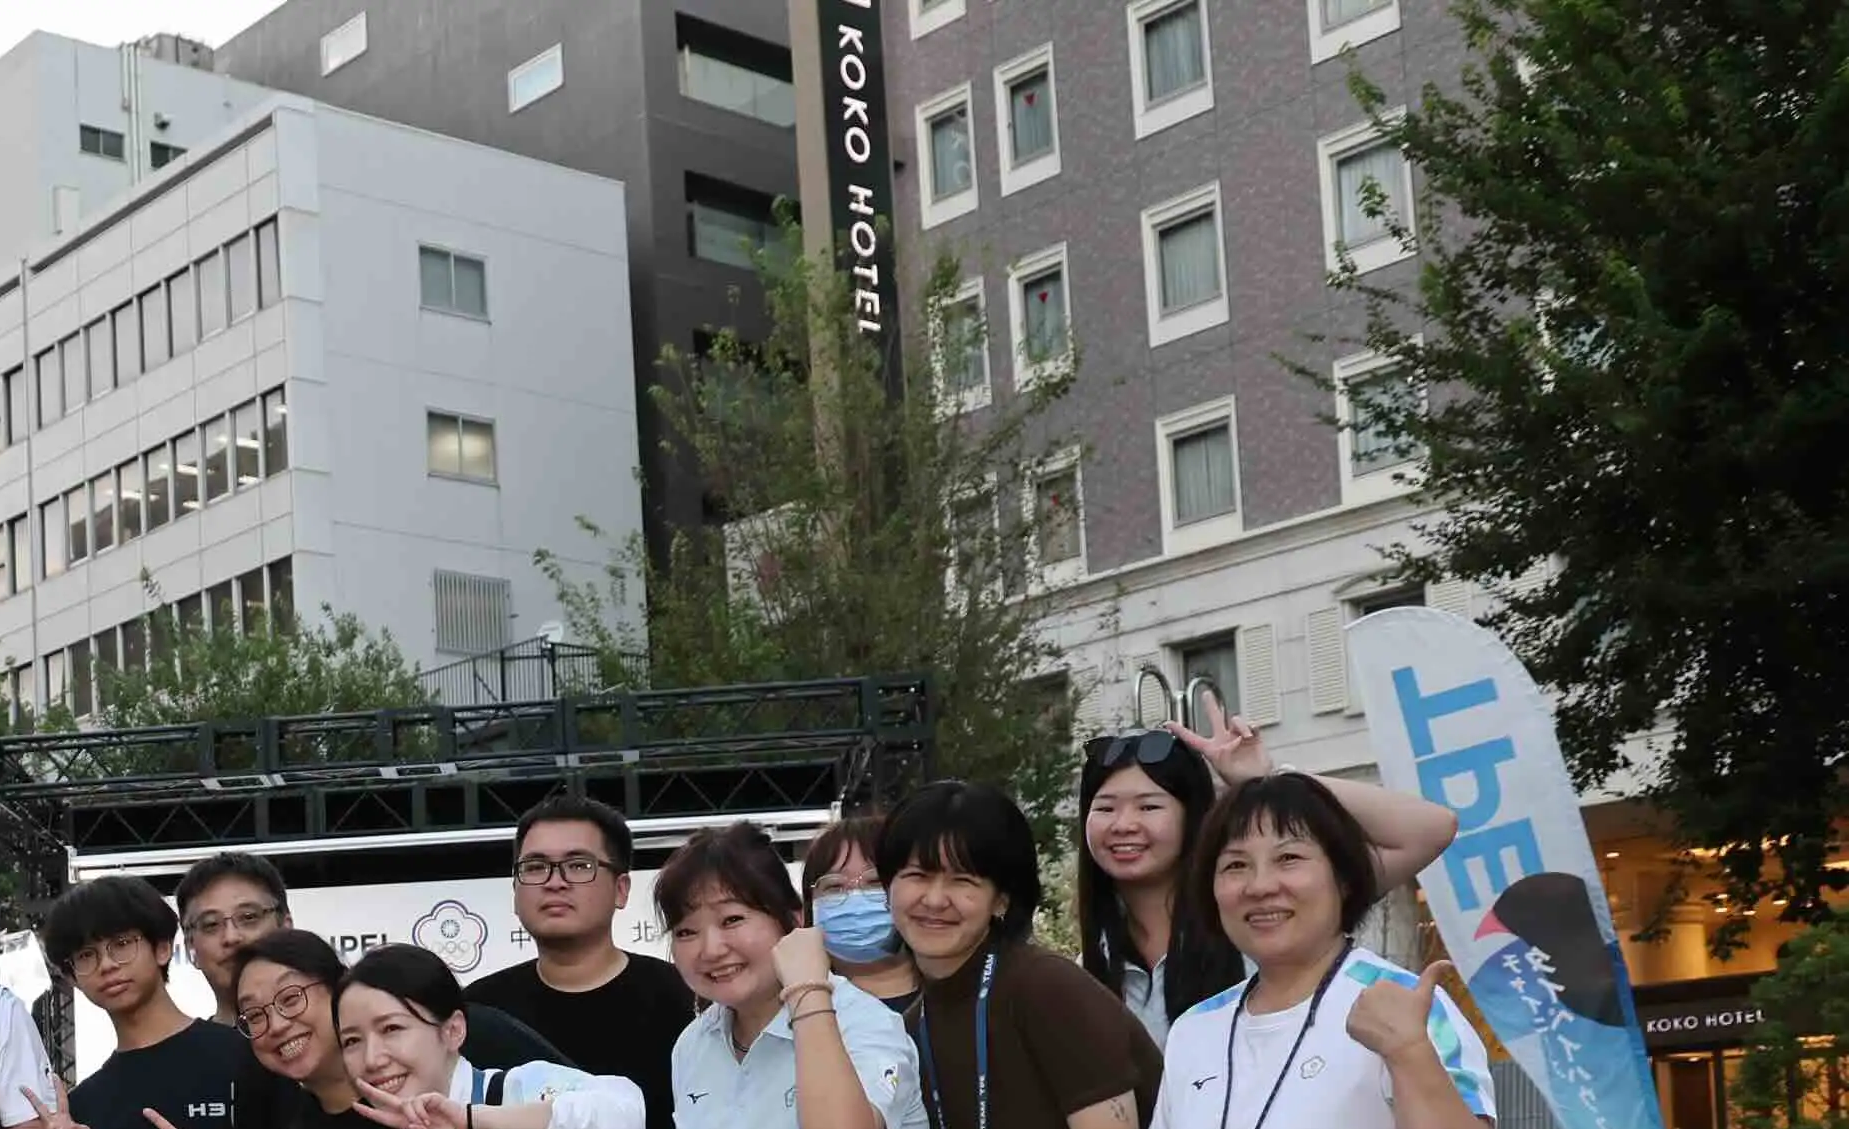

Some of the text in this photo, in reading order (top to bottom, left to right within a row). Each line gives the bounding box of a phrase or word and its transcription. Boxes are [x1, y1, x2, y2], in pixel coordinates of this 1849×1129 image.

[838, 24, 871, 164] KOKO
[848, 184, 882, 334] HOTEL
[982, 953, 996, 984] TEAM
[1646, 1009, 1767, 1033] KOKO HOTEL
